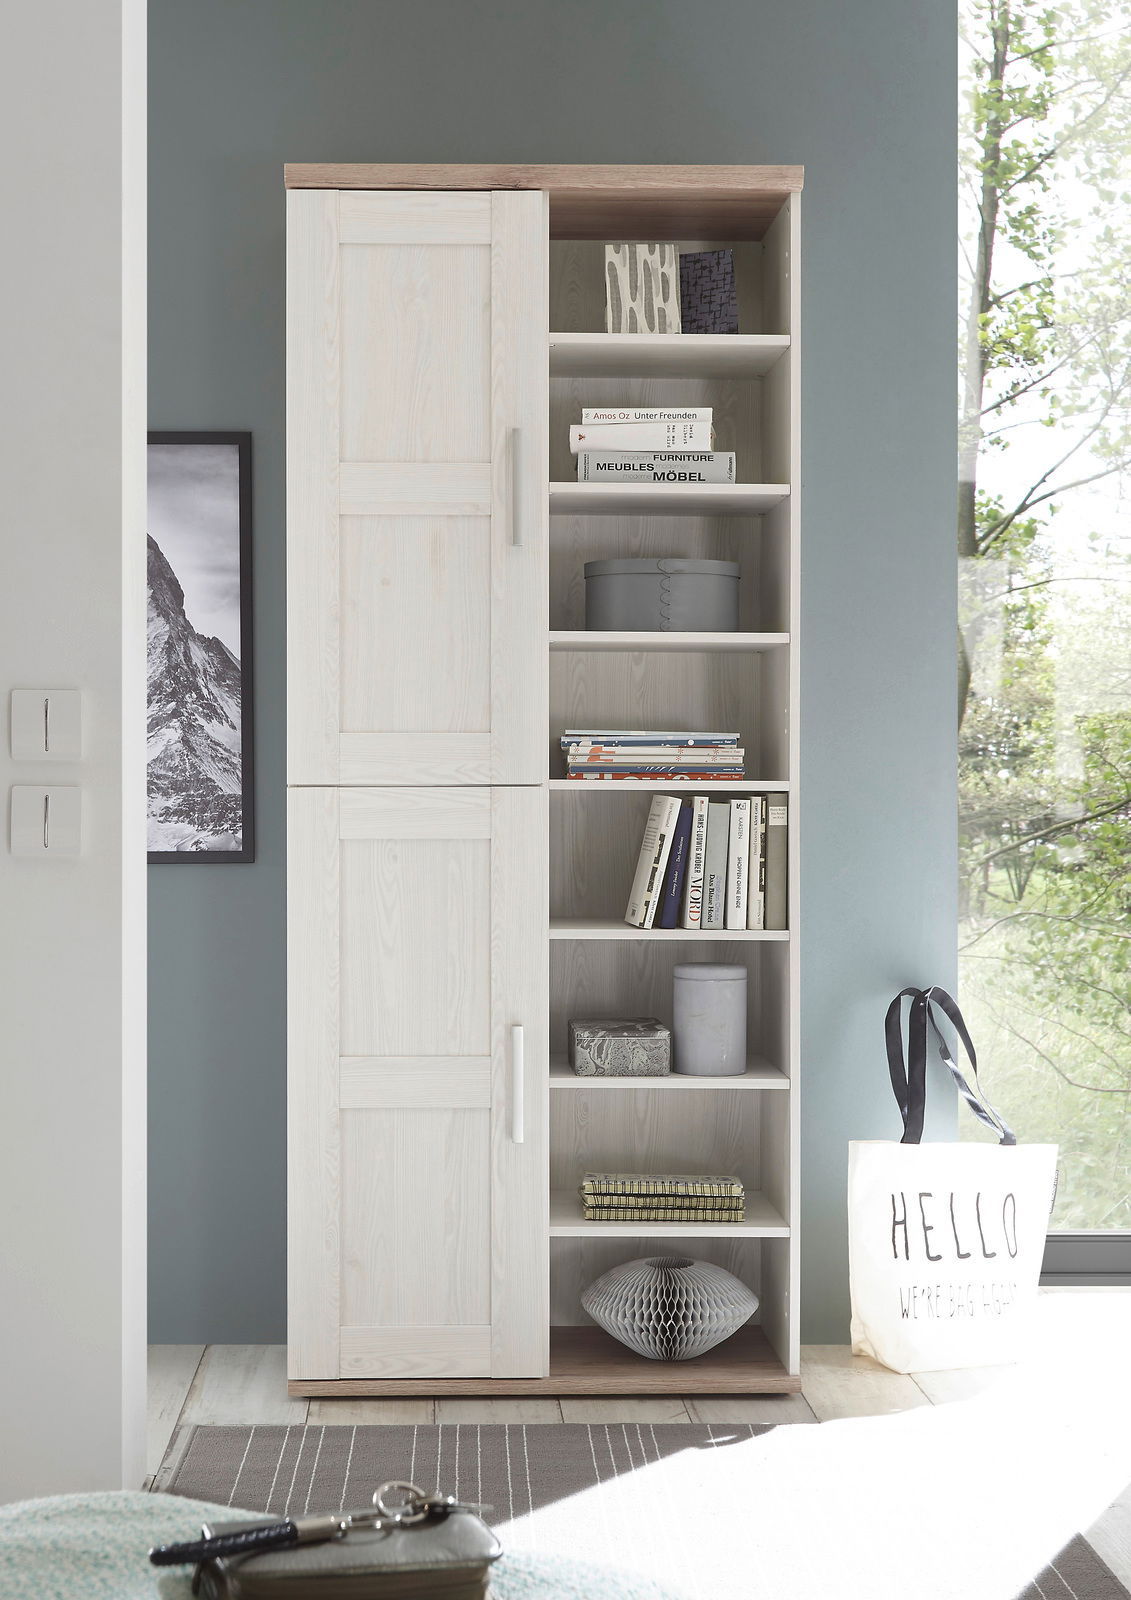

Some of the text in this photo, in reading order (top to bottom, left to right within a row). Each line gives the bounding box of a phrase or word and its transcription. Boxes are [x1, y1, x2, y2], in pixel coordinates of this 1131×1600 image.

[593, 411, 697, 420] Amos Oz Unter Freunden
[653, 454, 714, 462] FURNITURE
[596, 462, 655, 472] MEUBLES
[653, 470, 706, 482] MÖBEL
[695, 813, 705, 851] HANS-LUDWIG
[708, 874, 716, 887] Das
[688, 876, 703, 922] MORD
[891, 1191, 1018, 1261] HELLO
[900, 1285, 941, 1319] WE'RE
